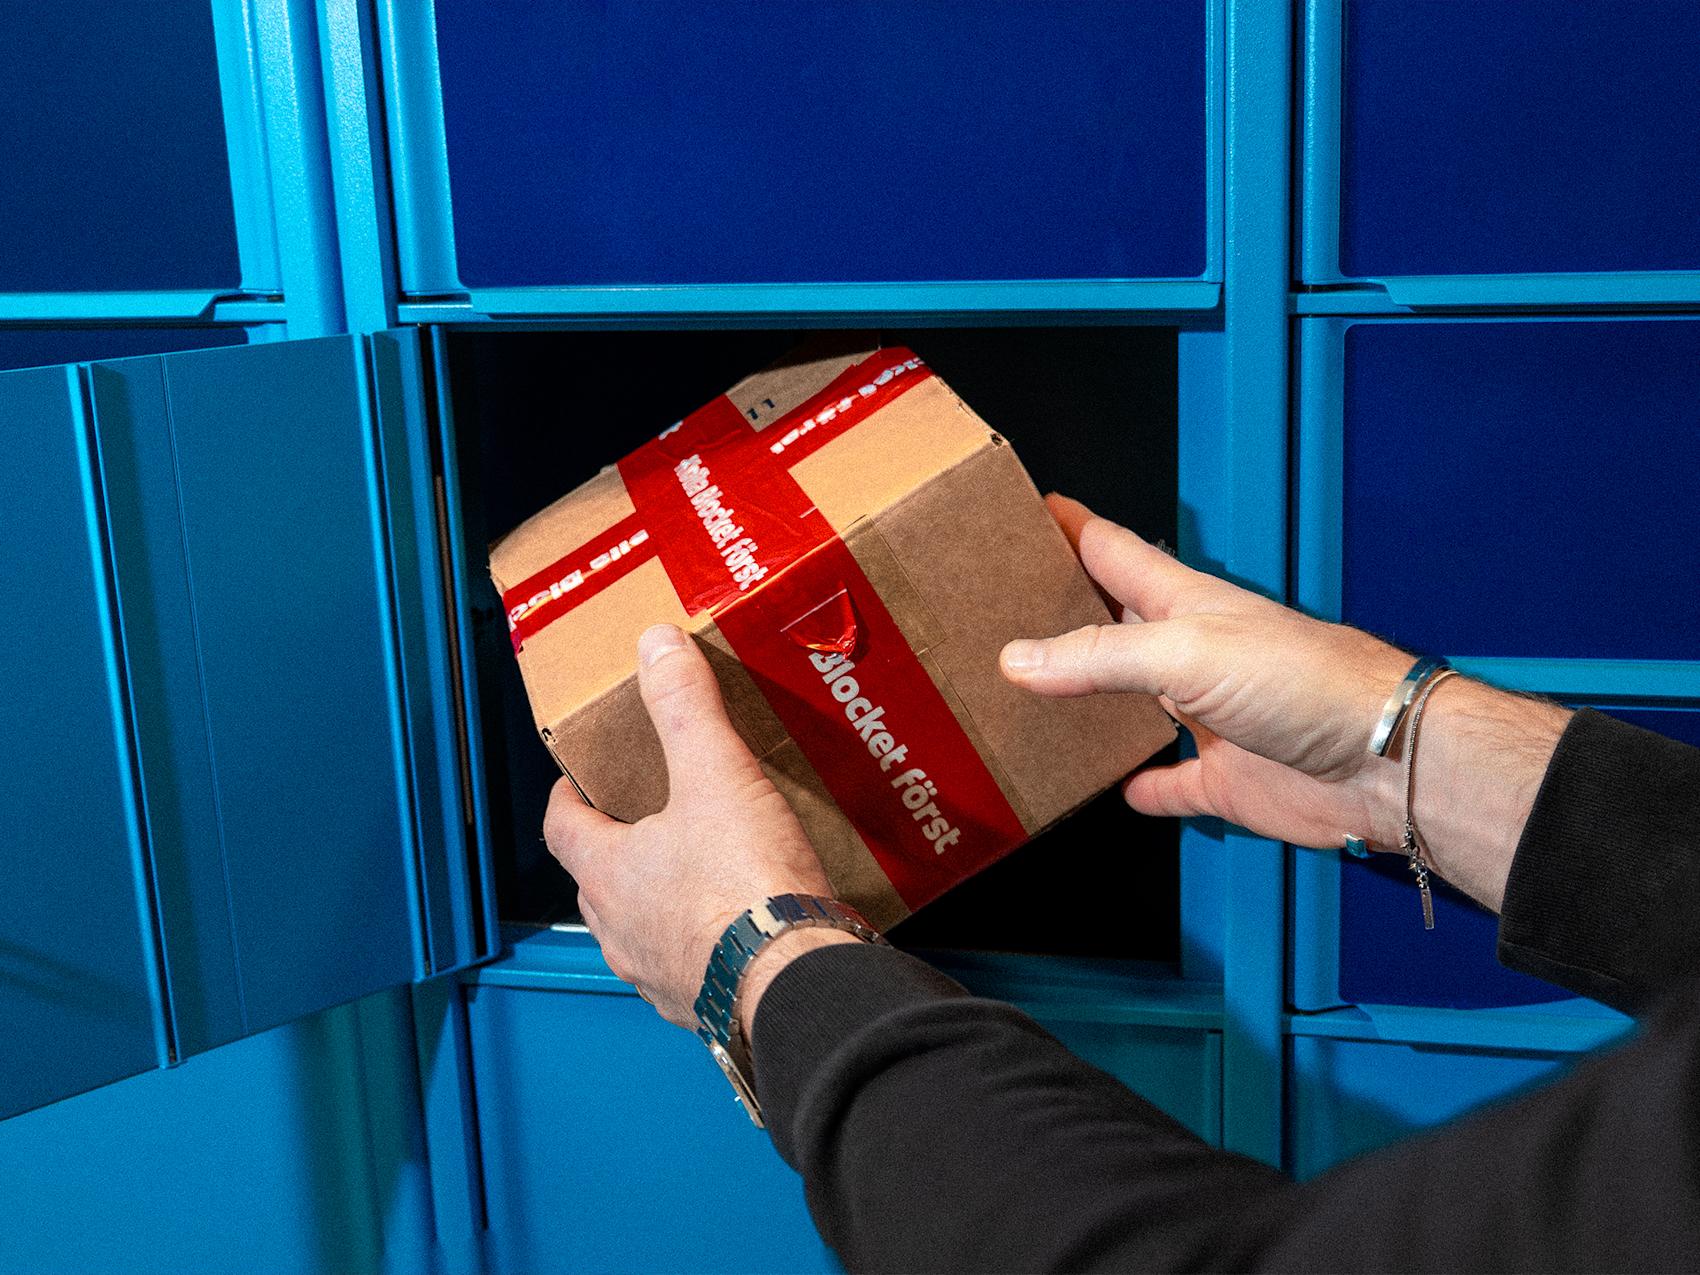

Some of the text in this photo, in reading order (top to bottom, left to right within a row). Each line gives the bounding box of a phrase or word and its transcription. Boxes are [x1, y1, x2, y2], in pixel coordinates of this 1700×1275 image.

[589, 529, 650, 571] olla
[720, 537, 769, 591] först
[808, 652, 961, 856] Blocket först
